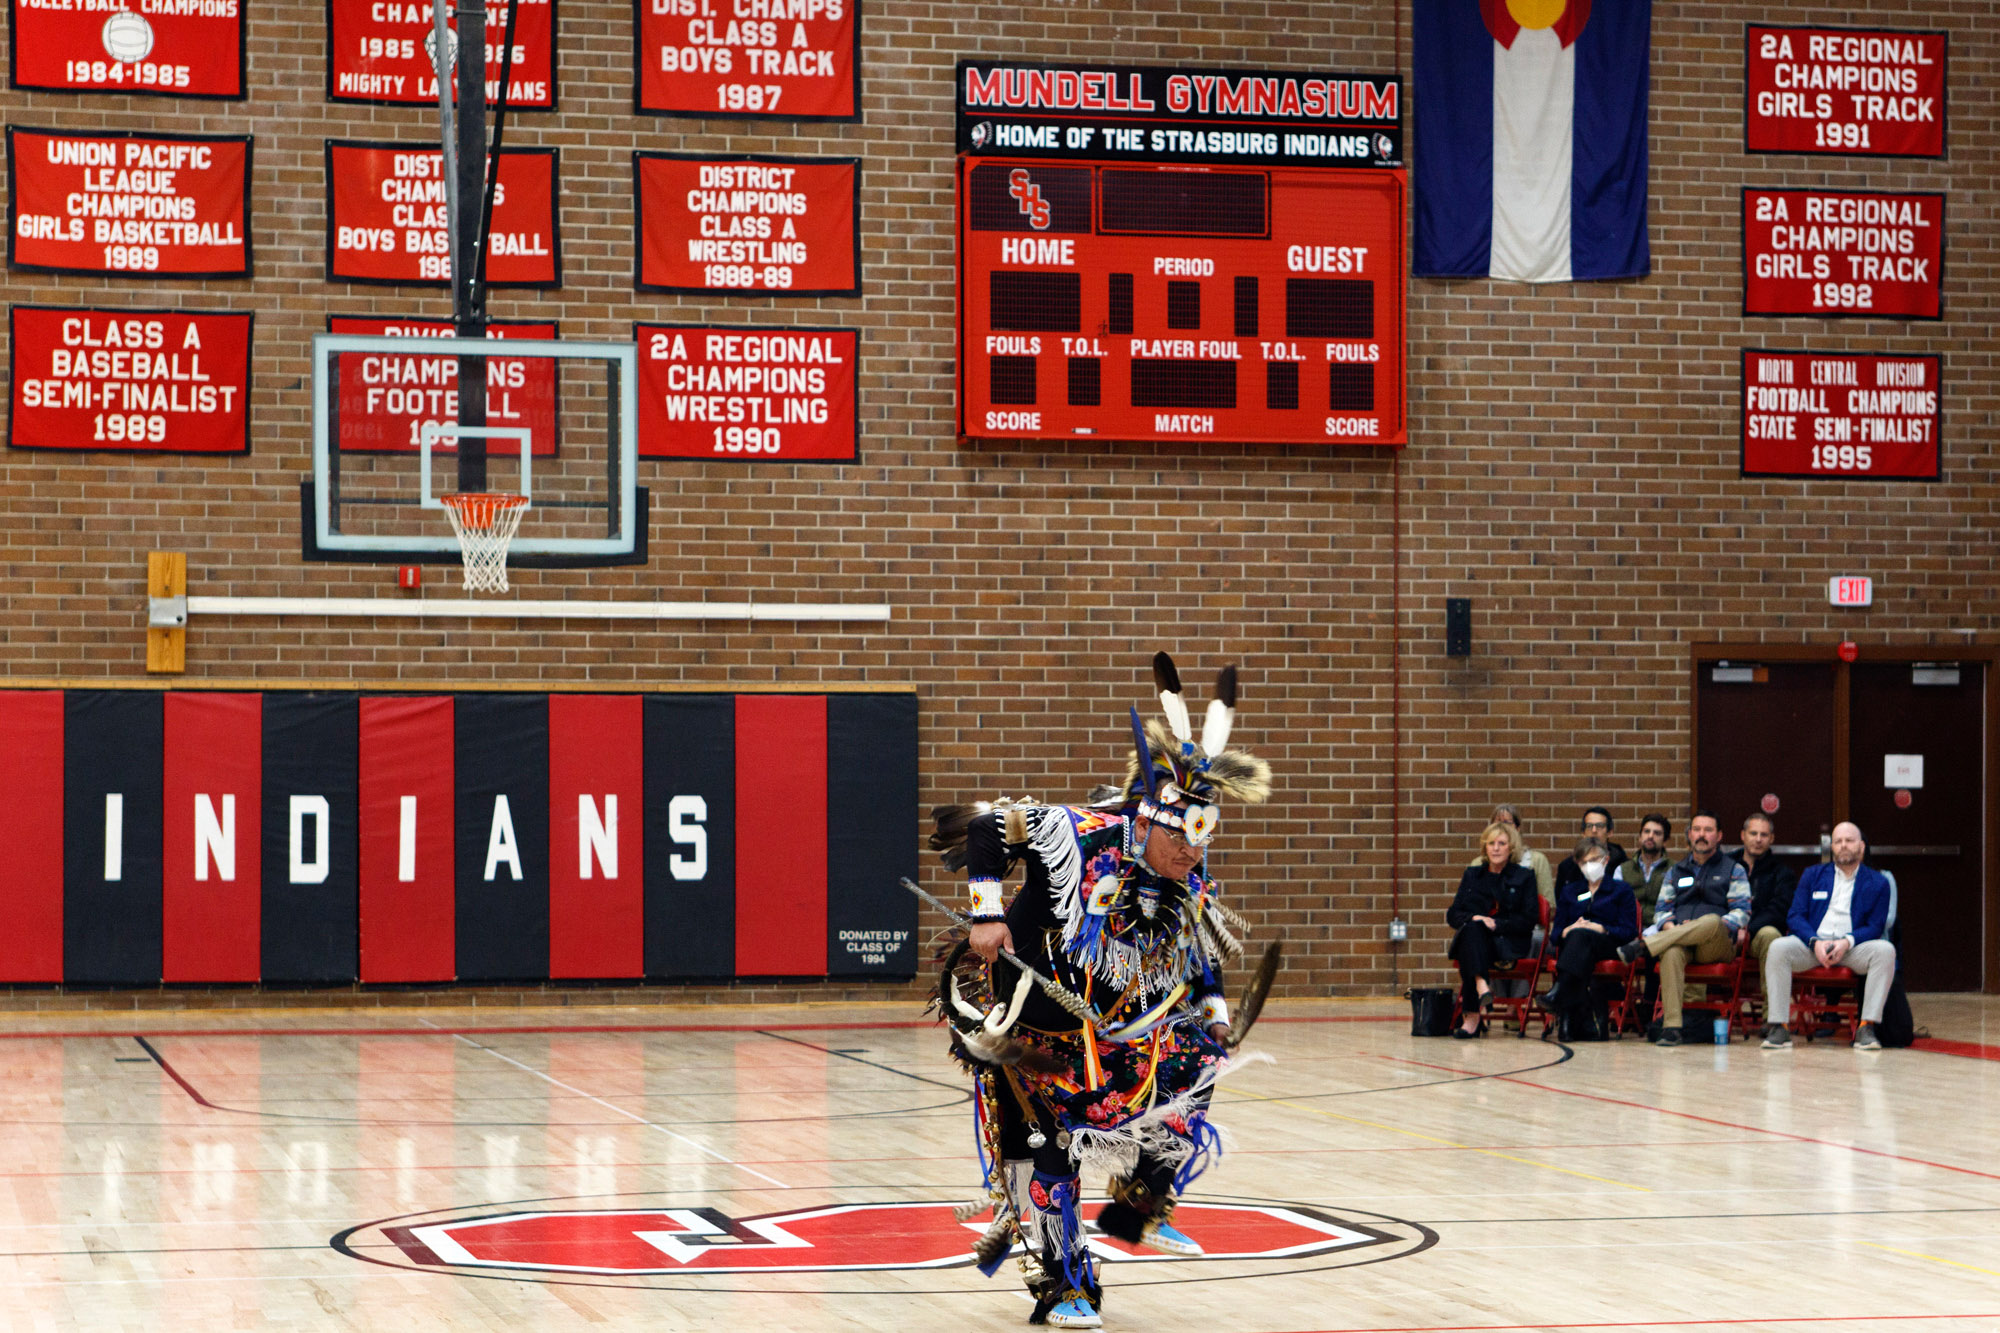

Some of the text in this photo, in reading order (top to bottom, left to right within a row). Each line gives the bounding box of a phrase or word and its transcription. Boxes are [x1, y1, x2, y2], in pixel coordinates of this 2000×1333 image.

[141, 0, 238, 18] CHAMPIONS
[372, 2, 509, 27] CHAMNS
[652, 0, 843, 21] DIST. CHAMPS
[689, 19, 808, 48] CLASS A
[361, 37, 526, 65] 1985 986
[662, 46, 834, 76] BOYS TRACK
[1761, 35, 1932, 64] 2A REGIONAL
[67, 61, 189, 87] 1984-1985
[340, 73, 405, 94] MIGHTY
[1775, 64, 1917, 93] CHAMPIONS
[717, 84, 782, 110] 1987
[965, 67, 1155, 112] MUNDELL
[1758, 92, 1933, 121] GIRLS TRACK
[996, 125, 1059, 148] HOME
[1067, 127, 1095, 148] OF
[1102, 128, 1144, 150] THE
[1151, 130, 1277, 154] STRASBURG
[1816, 123, 1870, 147] 1991
[48, 140, 211, 169] UNION PACIFIC
[85, 168, 176, 194] LEAGUE
[700, 166, 795, 190] DISTRICT
[382, 179, 505, 206] CHAMS
[688, 190, 806, 215] CHAMPIONS
[1008, 168, 1051, 230] SHS
[67, 193, 195, 220] CHAMPIONS
[393, 204, 448, 228] CLAS
[1756, 197, 1929, 226] 2A REGIONAL
[18, 214, 242, 245] GIRLS BASKETBALL
[701, 215, 796, 239] CLASS A
[1772, 226, 1913, 253] CHAMPIONS
[338, 226, 549, 256] BOYS BASBALL
[689, 240, 807, 264] WRESTLING
[1001, 237, 1076, 267] HOME
[104, 245, 159, 270] 1989
[1153, 256, 1215, 278] PERIOD
[1287, 244, 1368, 274] GUEST
[1756, 254, 1928, 282] GIRLS TRACK
[704, 265, 792, 288] 1988-89
[1813, 283, 1872, 307] 1992
[64, 319, 200, 349] CLASS A
[985, 335, 1042, 356] FOULS
[651, 334, 842, 363] 2A REGIONAL
[1062, 338, 1109, 357] T.O.L.
[1130, 339, 1242, 360] PLAYER FOUL
[1260, 342, 1307, 361] T.O.L.
[1326, 343, 1380, 362] FOULS
[53, 350, 209, 381] BASEBALL
[362, 356, 526, 388] CHAMPNS
[1759, 359, 1924, 386] NORTH CENTRAL DIVISION
[668, 365, 825, 394] CHAMPIONS
[24, 380, 236, 412] SEMI-FINALIST
[366, 387, 521, 418] FOOTBLL
[666, 395, 828, 423] WRESTLING
[1748, 386, 1936, 414] FOOTBALL CHAMPIONS
[95, 414, 165, 442] 1989
[985, 411, 1042, 431] SCORE
[1154, 414, 1215, 434] MATCH
[1325, 417, 1380, 437] SCORE
[1749, 415, 1931, 442] STATE SEMI-FINALIST
[714, 427, 780, 453] 1990
[1812, 445, 1871, 469] 1995
[1838, 578, 1867, 603] EXIT
[839, 930, 909, 941] DONATED BY
[846, 942, 901, 952] CLASS OF
[862, 954, 886, 964] 1994
